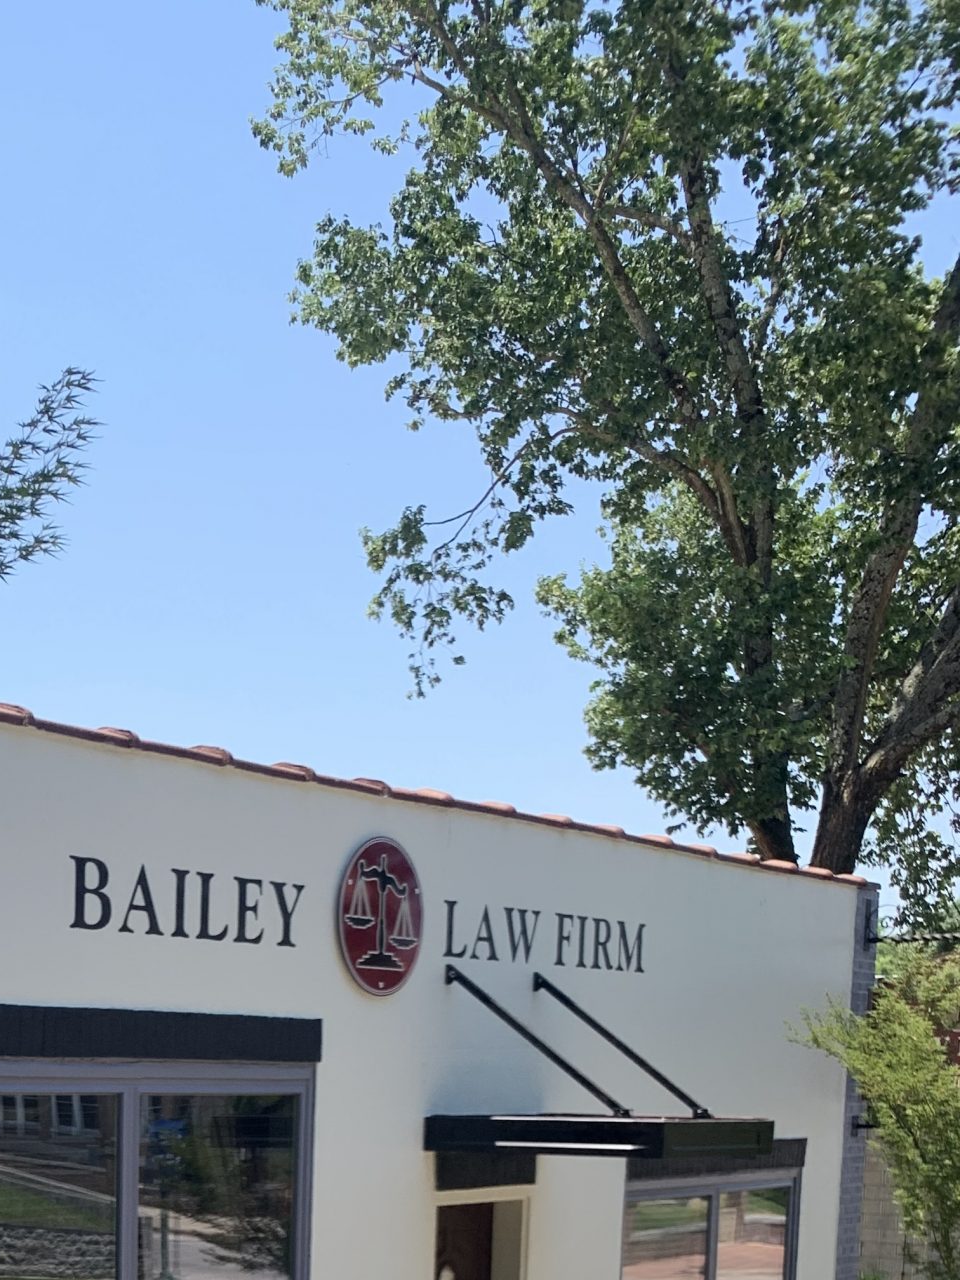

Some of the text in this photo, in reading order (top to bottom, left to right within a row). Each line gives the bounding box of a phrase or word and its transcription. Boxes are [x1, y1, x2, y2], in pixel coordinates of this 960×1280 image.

[69, 855, 647, 974] BAILEY LAW FIRM
